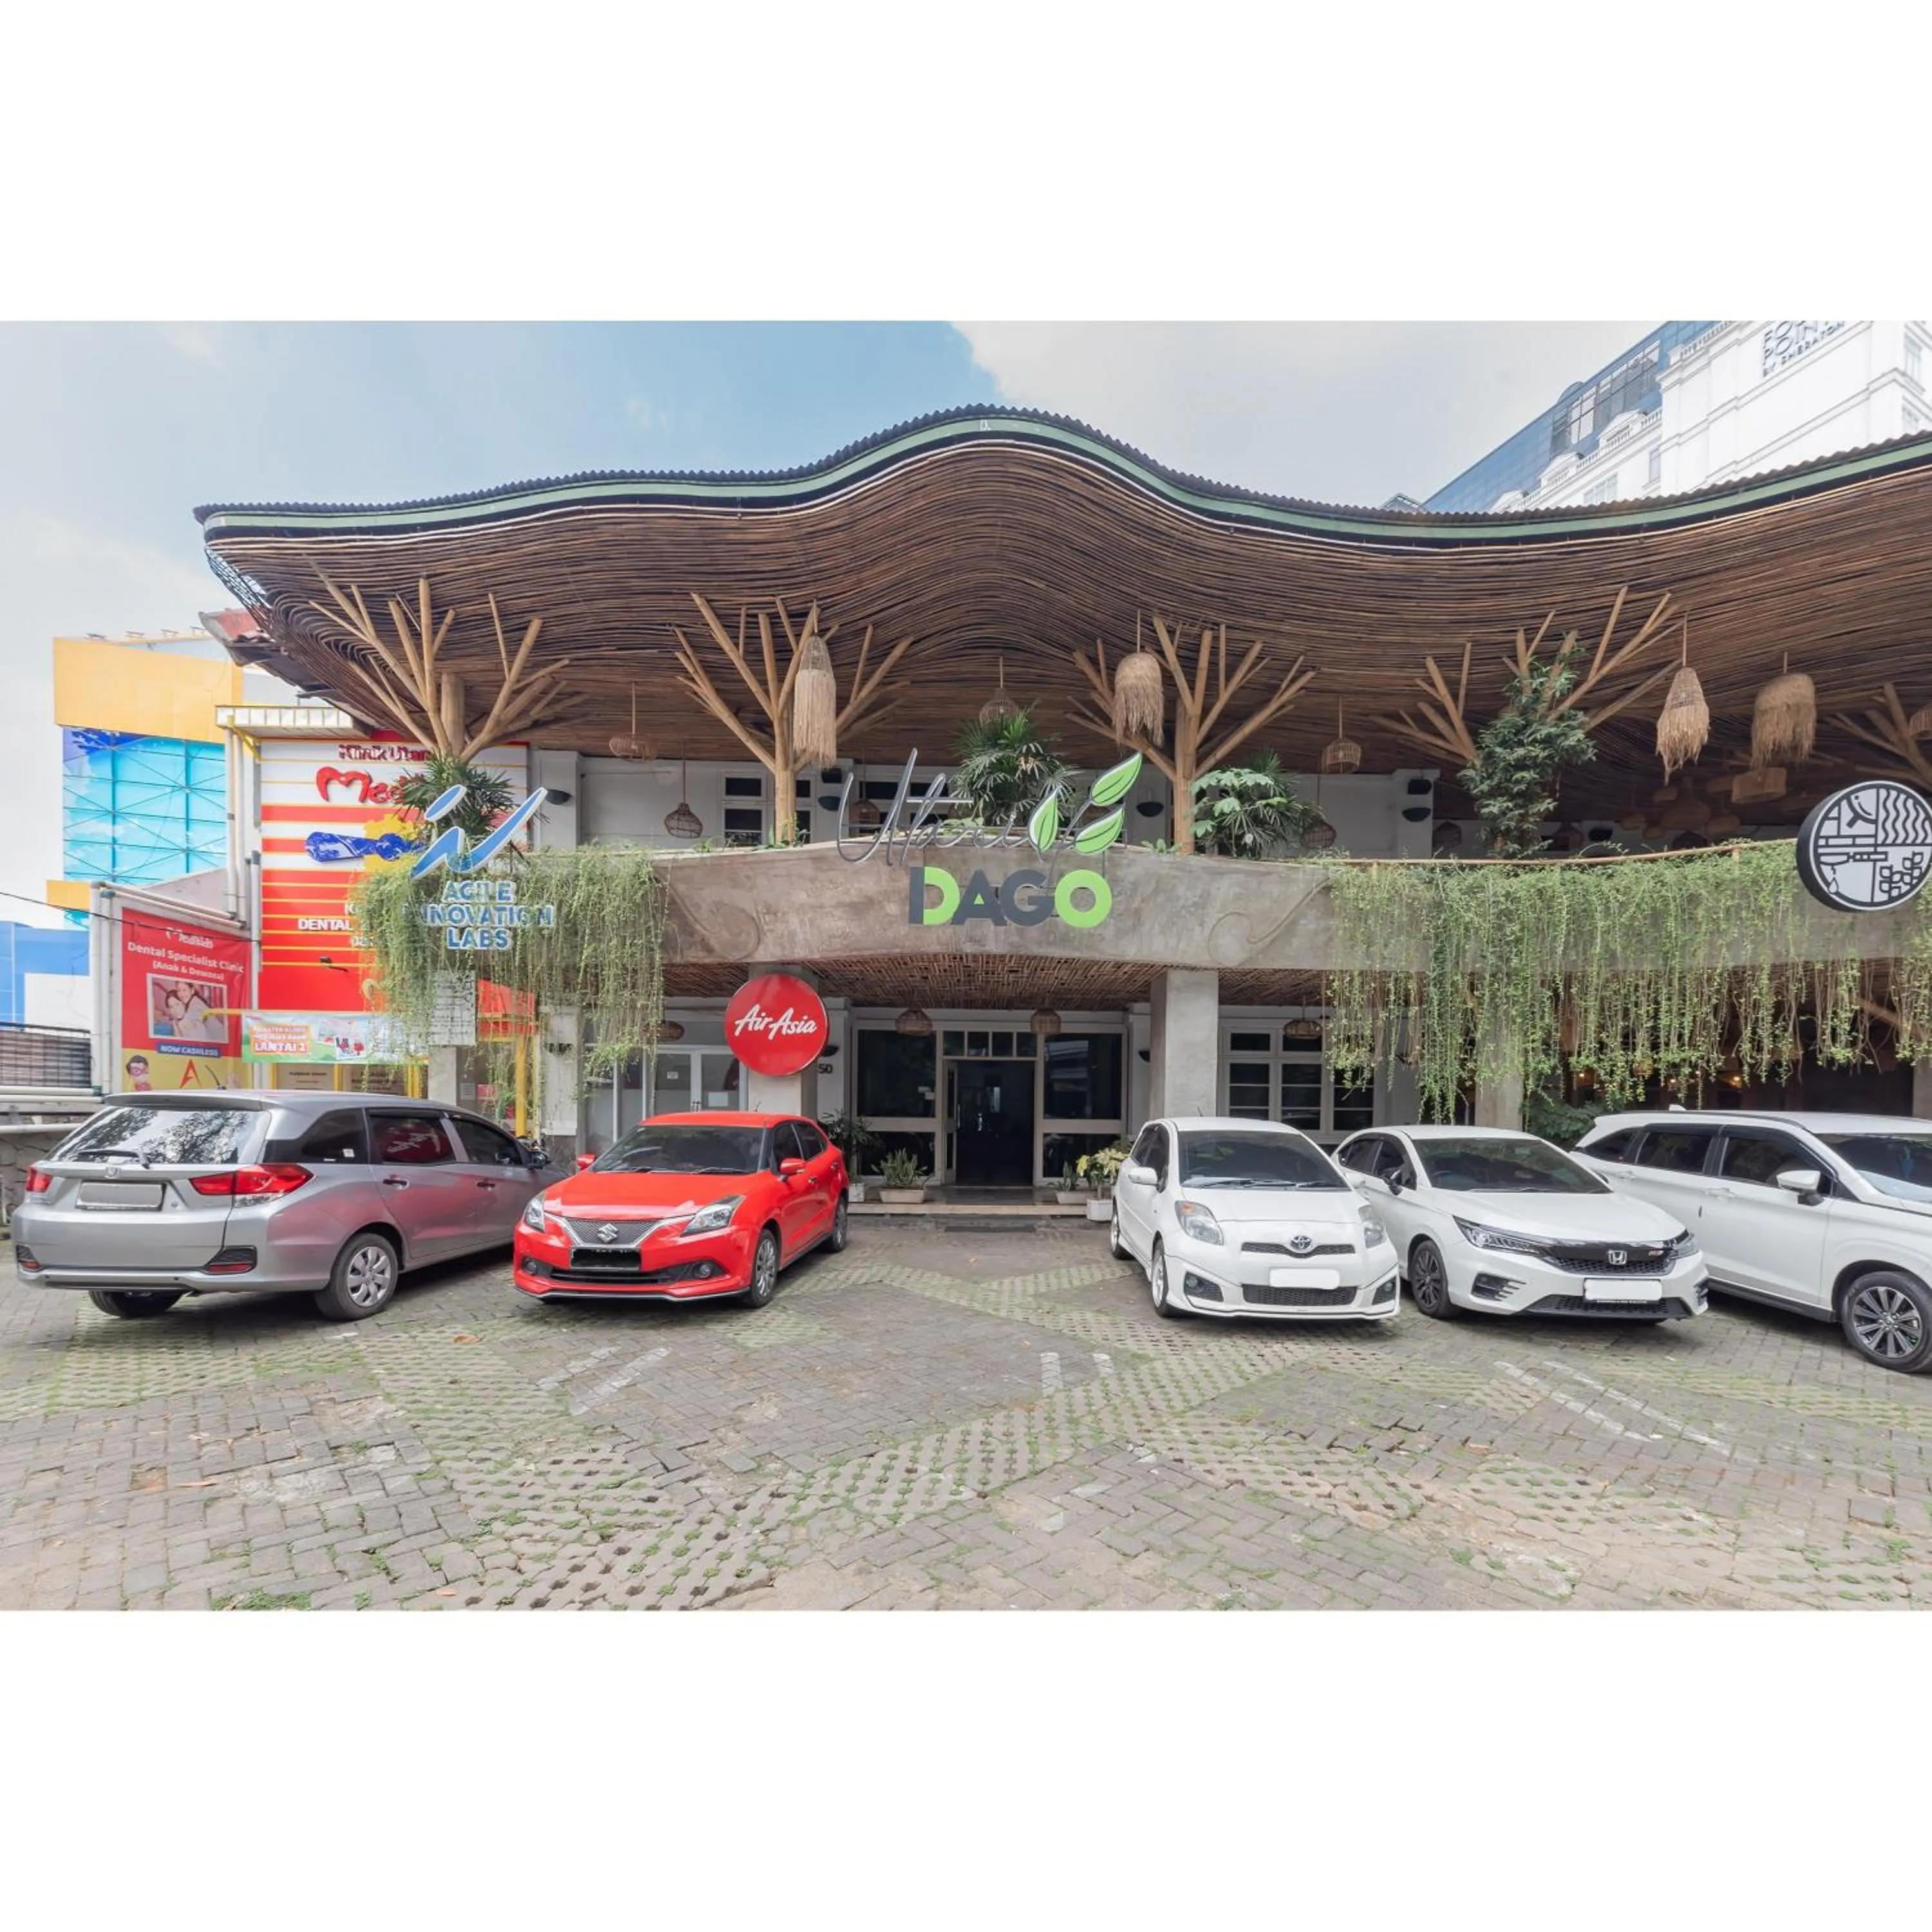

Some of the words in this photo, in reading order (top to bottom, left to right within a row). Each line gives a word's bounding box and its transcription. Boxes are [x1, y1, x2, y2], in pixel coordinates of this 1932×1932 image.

[1763, 321, 1806, 348] FO
[1763, 321, 1828, 366] POIN
[909, 866, 1112, 928] DAGO
[298, 918, 354, 931] DENTAL
[447, 927, 513, 950] LABS
[128, 942, 165, 958] Dental
[167, 949, 218, 968] Specialist
[219, 960, 244, 973] Clinic
[734, 1004, 817, 1040] AirAsia
[160, 1044, 180, 1053] NOW
[819, 1064, 833, 1074] 50
